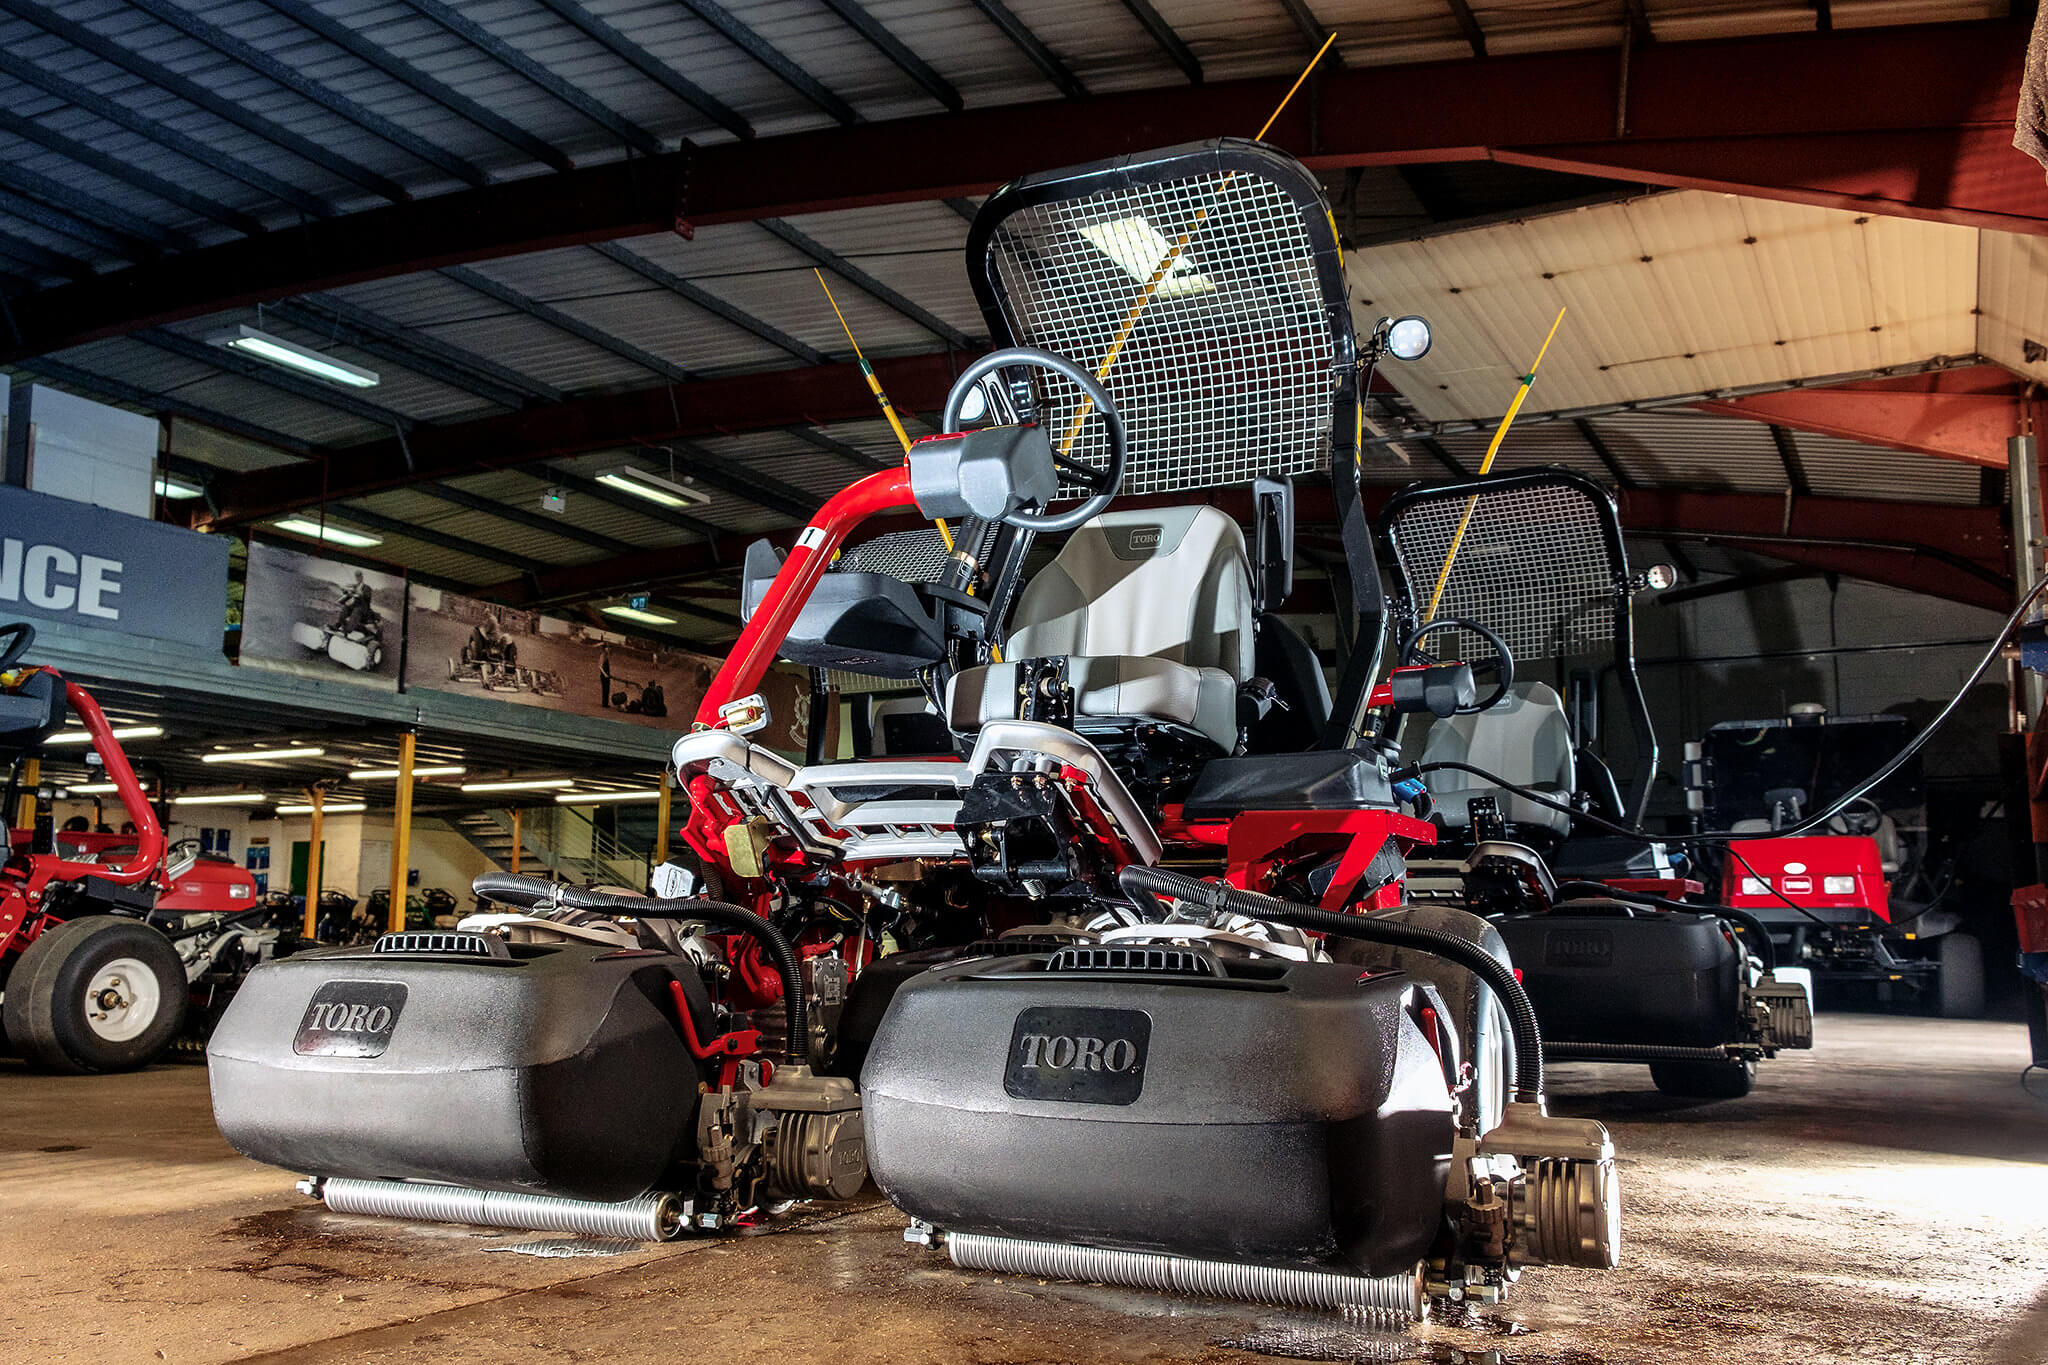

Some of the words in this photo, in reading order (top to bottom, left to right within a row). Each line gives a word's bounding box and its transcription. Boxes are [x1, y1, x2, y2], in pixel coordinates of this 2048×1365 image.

[803, 528, 816, 545] 1
[1132, 534, 1160, 544] TORO
[309, 1003, 392, 1032] TORO
[1020, 1034, 1137, 1072] TORO
